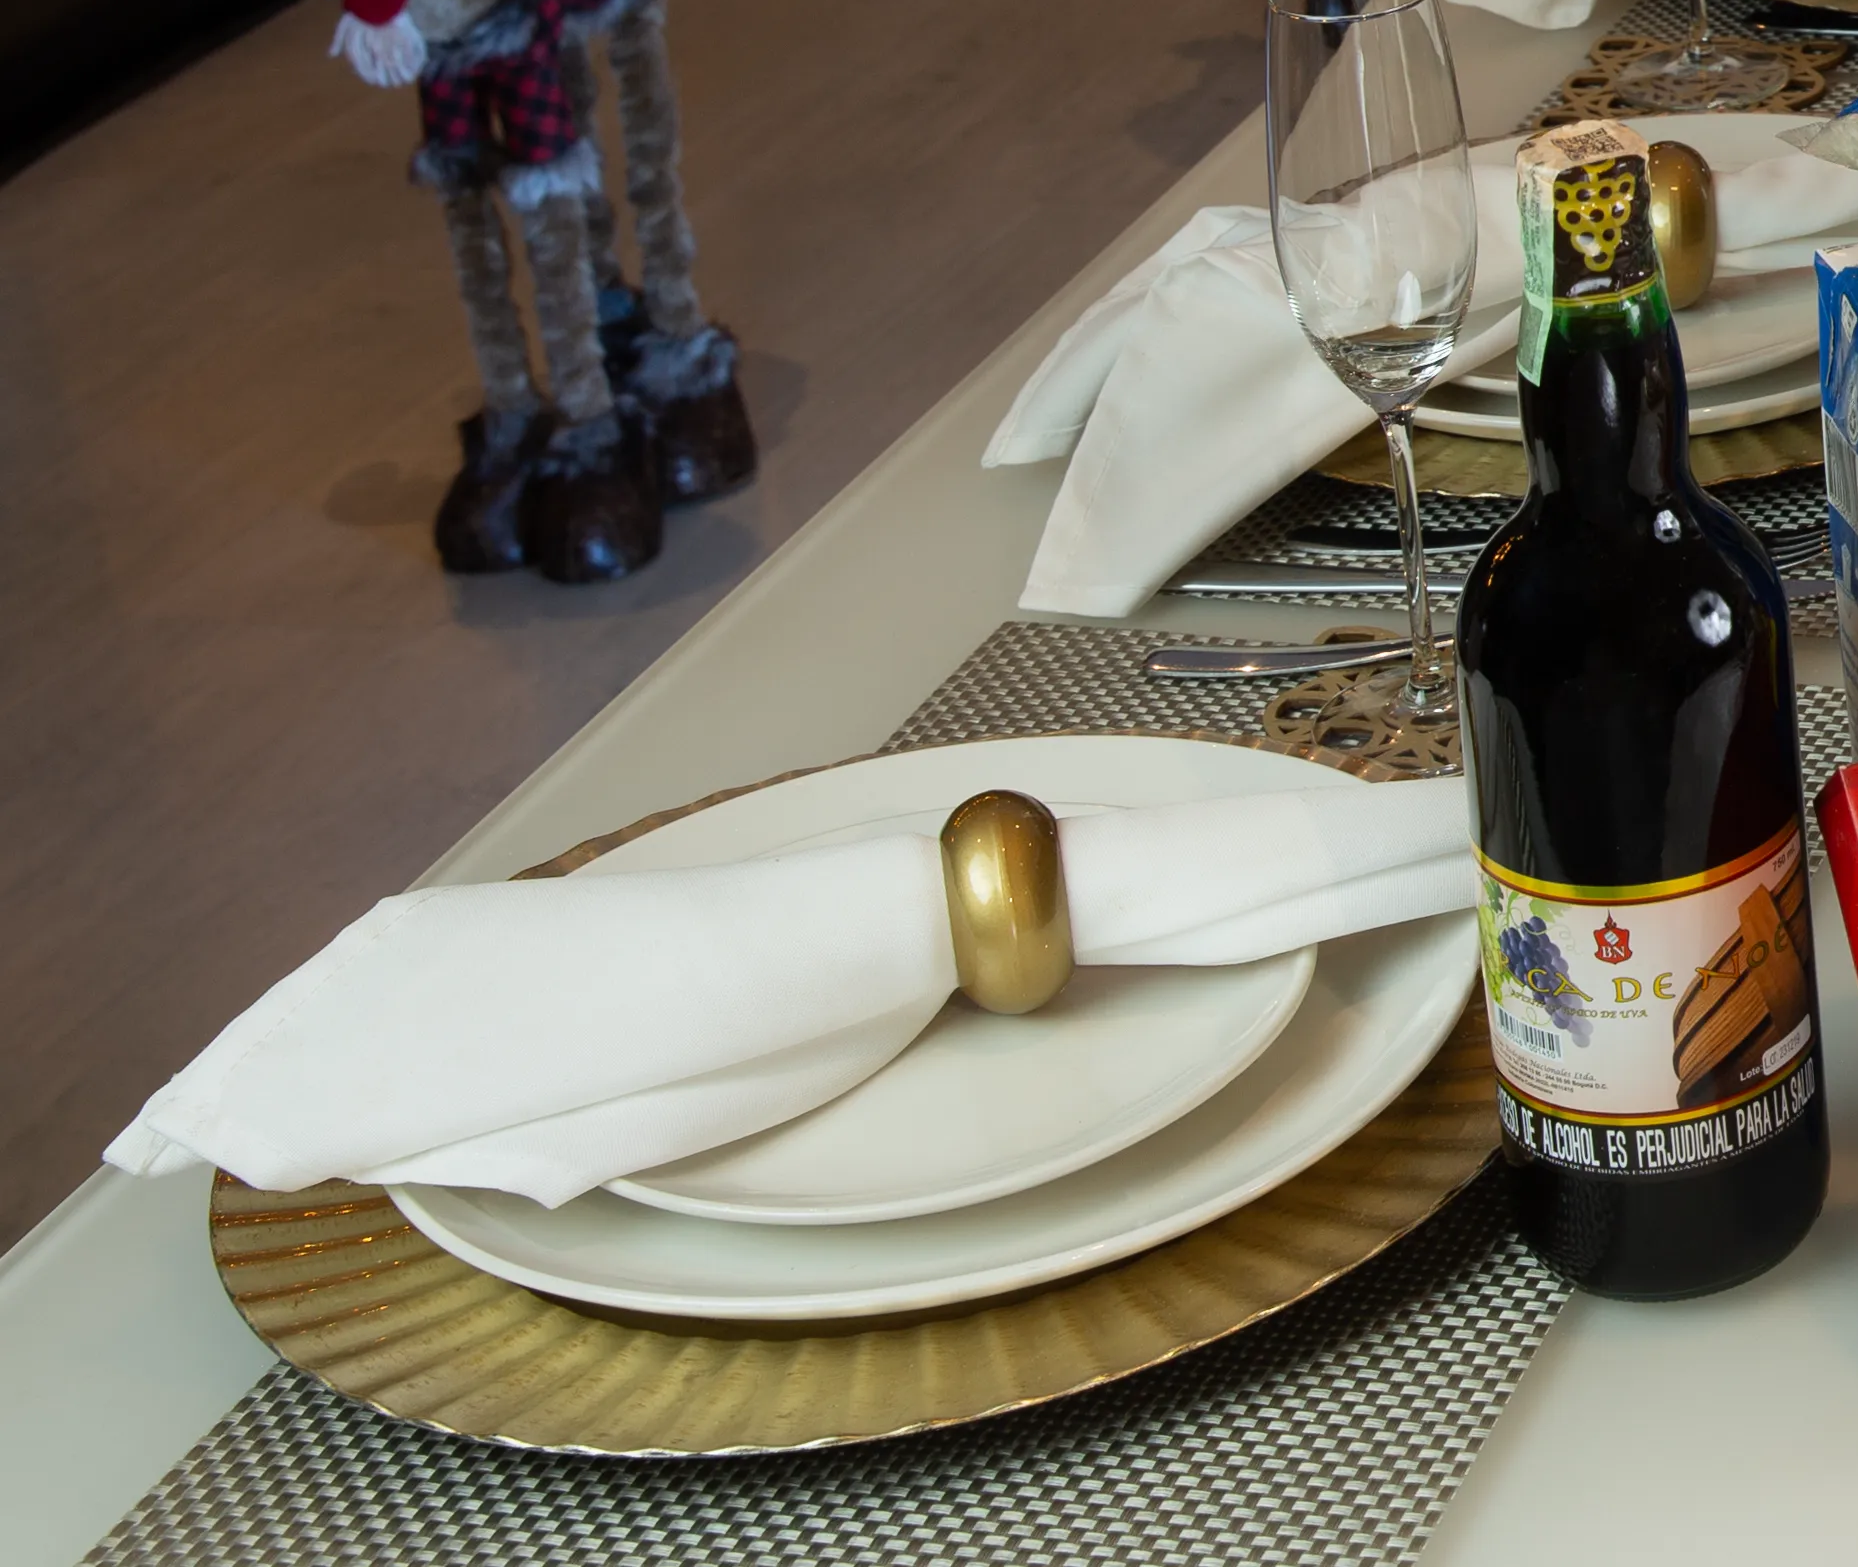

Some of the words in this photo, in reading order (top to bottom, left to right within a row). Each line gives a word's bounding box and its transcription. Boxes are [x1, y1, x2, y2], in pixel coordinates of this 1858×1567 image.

[1601, 945, 1626, 959] BN
[1496, 1084, 1519, 1137] CESO
[1521, 1106, 1537, 1149] DE
[1542, 1117, 1600, 1167] ALCOHOL
[1606, 1130, 1628, 1169] ES
[1635, 1114, 1734, 1169] PERJUDICIAL
[1735, 1096, 1772, 1147] PARA
[1773, 1084, 1790, 1128] LA
[1790, 1056, 1816, 1114] SALUD
